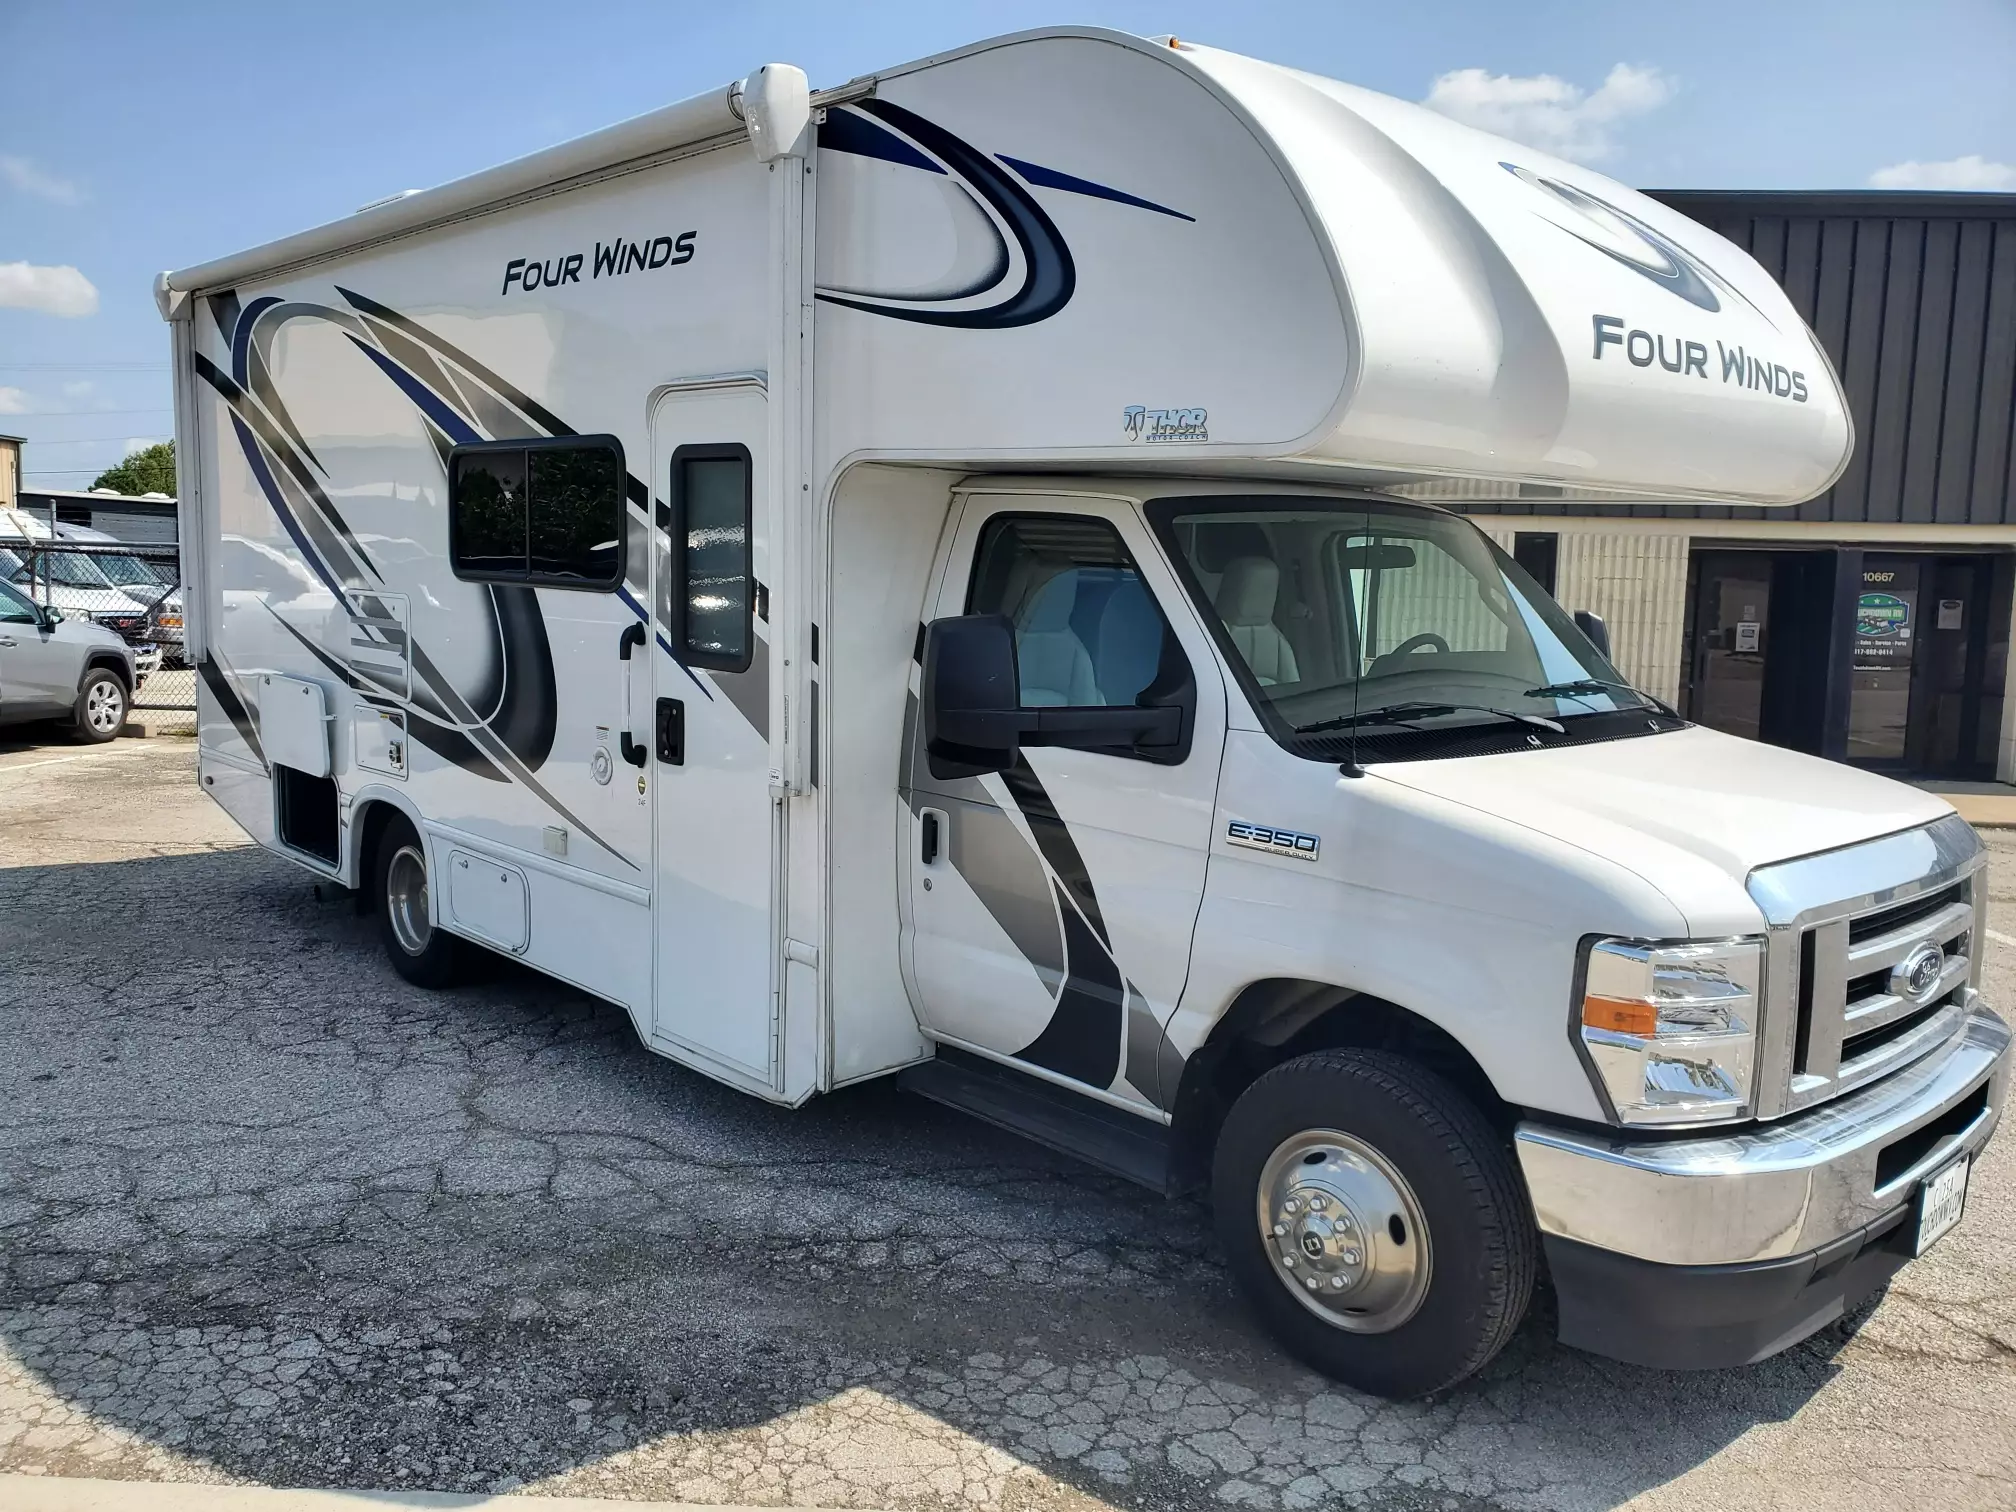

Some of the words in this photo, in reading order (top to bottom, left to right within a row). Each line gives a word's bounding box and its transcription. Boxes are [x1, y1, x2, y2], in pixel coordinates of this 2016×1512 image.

[1146, 407, 1208, 435] THOR
[1862, 572, 1895, 582] 10667
[1264, 846, 1290, 855] SUPER
[1292, 851, 1314, 860] DUTY
